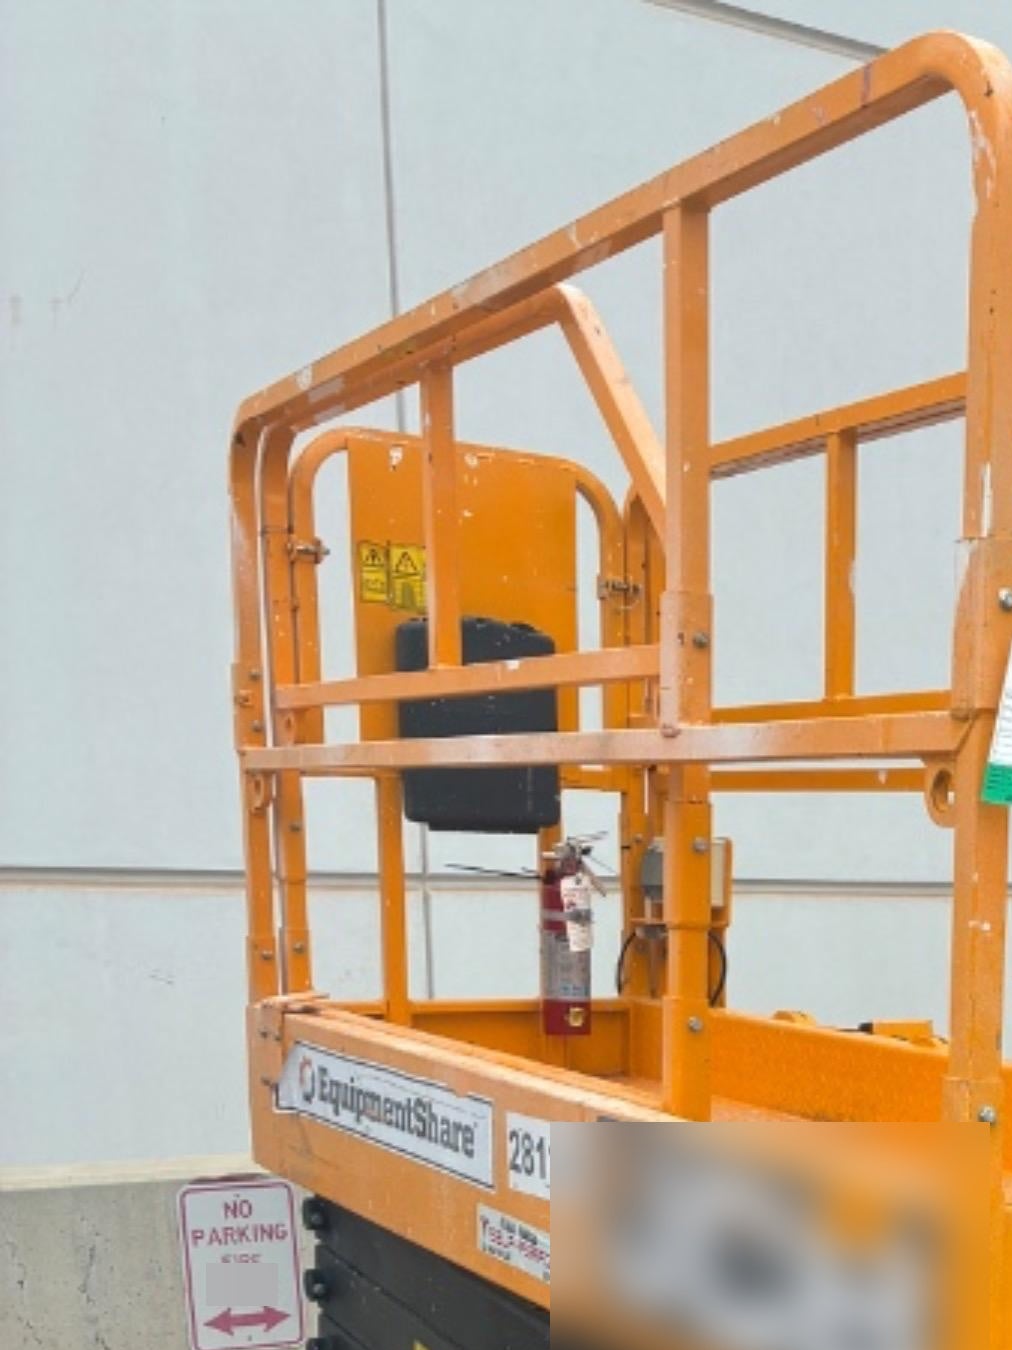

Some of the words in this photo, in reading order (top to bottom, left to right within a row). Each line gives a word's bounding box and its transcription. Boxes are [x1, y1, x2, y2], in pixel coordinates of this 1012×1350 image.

[316, 1066, 476, 1160] EquipmentShare
[223, 1199, 253, 1219] NO
[191, 1223, 289, 1246] PARKING
